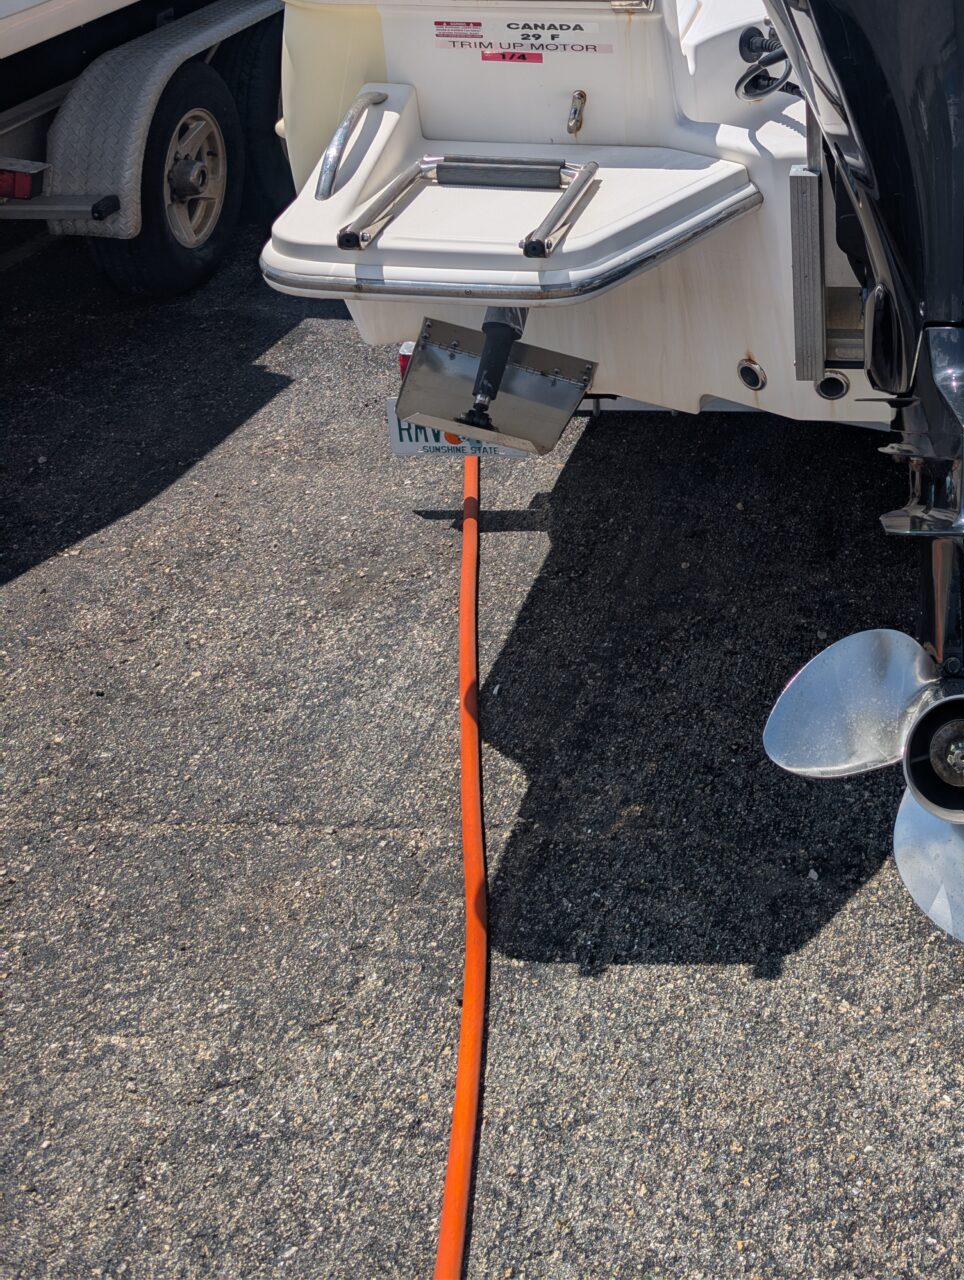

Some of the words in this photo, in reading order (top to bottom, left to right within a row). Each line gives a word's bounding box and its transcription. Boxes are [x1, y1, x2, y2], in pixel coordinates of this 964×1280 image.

[506, 22, 585, 32] CANADA
[520, 33, 542, 41] 29
[550, 33, 561, 41] F
[448, 40, 493, 50] TRIM
[499, 42, 525, 51] UP
[530, 43, 598, 53] MOTOR
[422, 445, 467, 454] SUNSHINE
[471, 446, 499, 455] STATE
